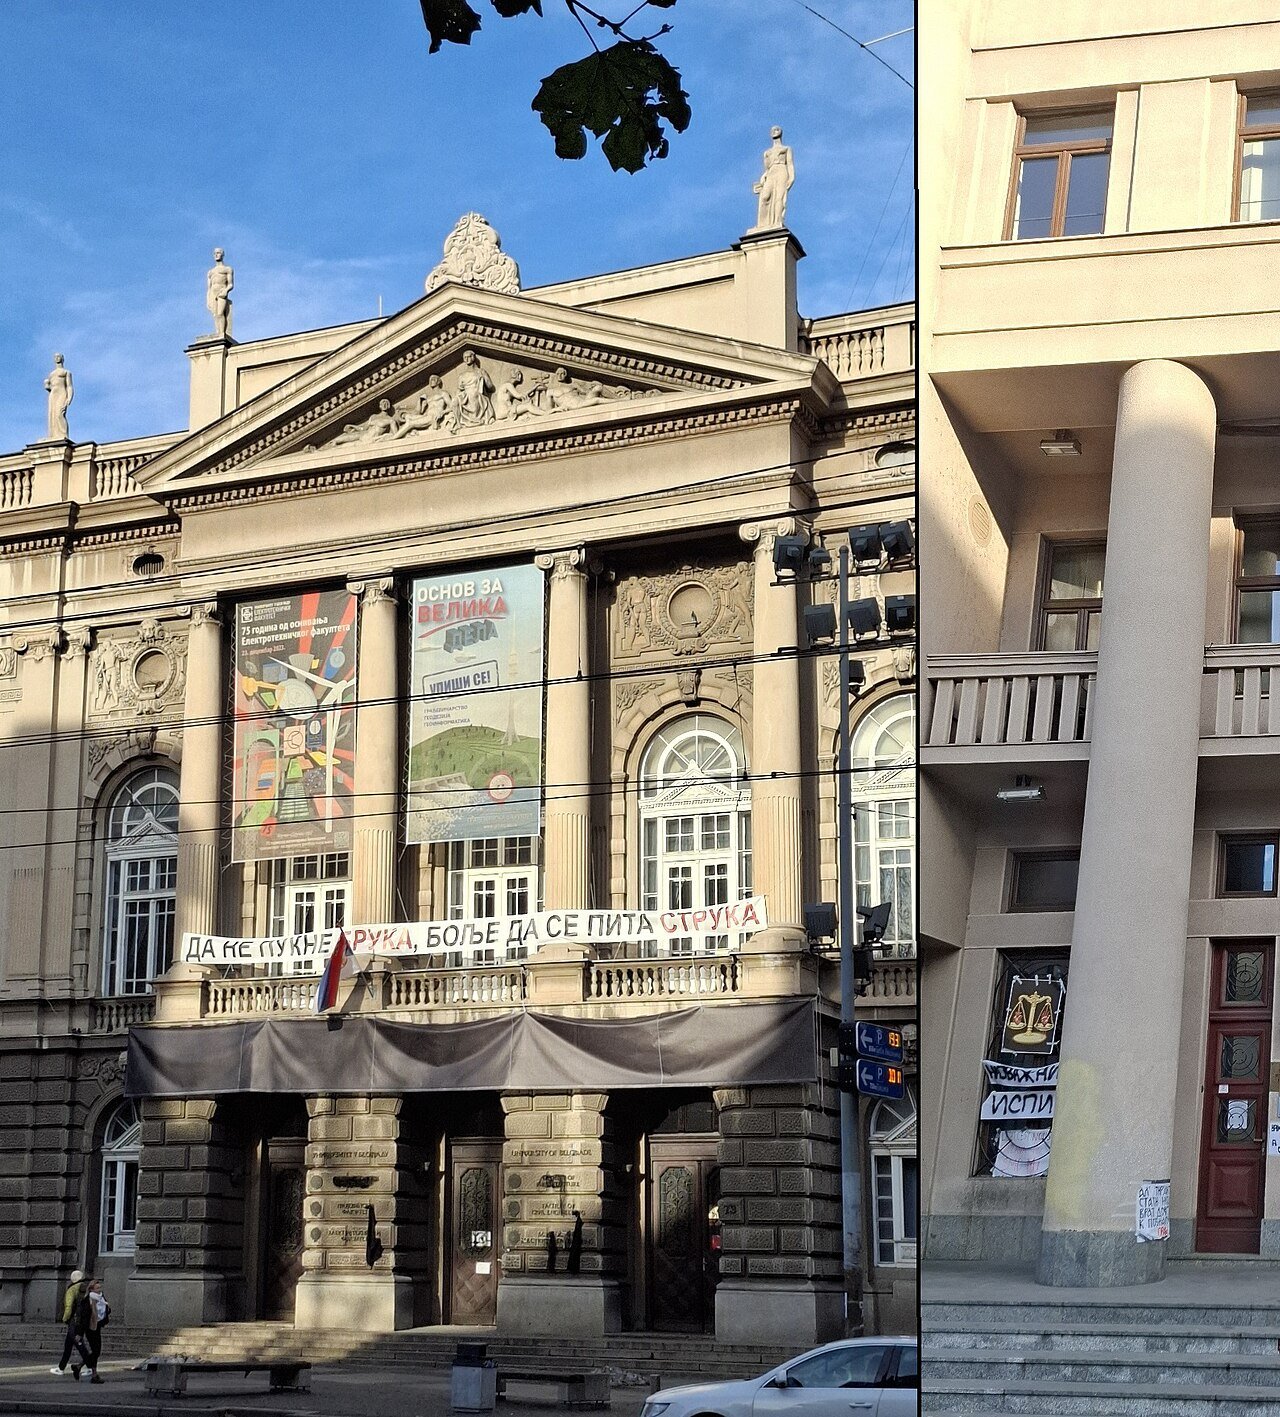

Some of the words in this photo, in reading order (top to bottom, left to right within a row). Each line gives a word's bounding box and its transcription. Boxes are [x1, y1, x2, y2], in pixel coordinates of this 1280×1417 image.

[417, 580, 475, 602] ОСНОВ
[481, 577, 504, 595] ЗА
[418, 596, 509, 624] ВЕЛИКА
[241, 629, 309, 646] Електротехничког
[310, 623, 351, 639] факултета
[242, 626, 251, 636] 75
[251, 624, 278, 636] година
[279, 622, 289, 631] од
[289, 616, 328, 628] оснивања
[429, 674, 471, 695] УПИШИ
[473, 670, 491, 687] СЕ!
[186, 935, 216, 962] ДА
[223, 940, 252, 959] НЕ
[260, 932, 333, 958] ПУКНЕ
[427, 922, 501, 948] БОЉЕ
[506, 917, 539, 946] ДА
[546, 913, 579, 938] СЕ
[587, 912, 654, 936] ПИТА
[660, 902, 761, 934] СТРУКА
